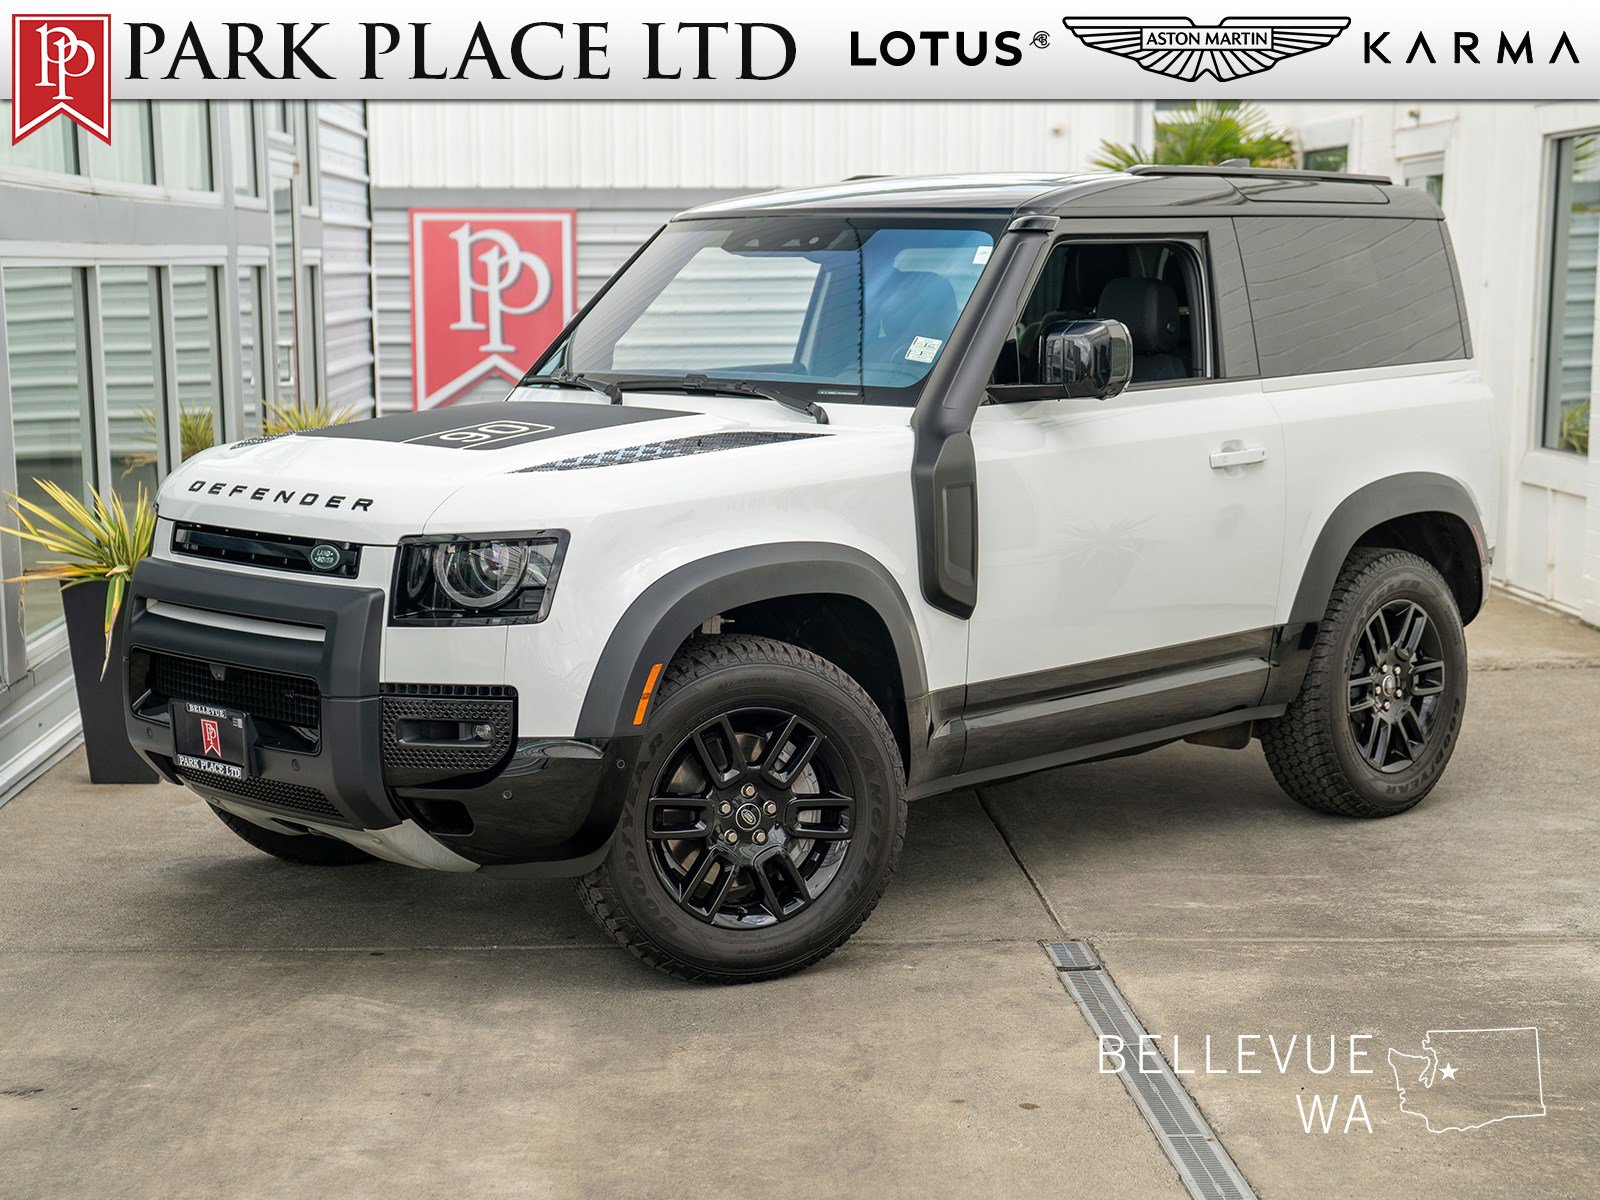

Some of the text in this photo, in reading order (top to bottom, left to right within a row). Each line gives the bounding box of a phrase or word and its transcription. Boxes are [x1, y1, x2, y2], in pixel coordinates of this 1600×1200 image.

[439, 423, 530, 443] 90
[188, 480, 374, 512] DEFENDER
[189, 704, 225, 718] BELLEVUE
[179, 756, 241, 779] PARK PLACE LTD
